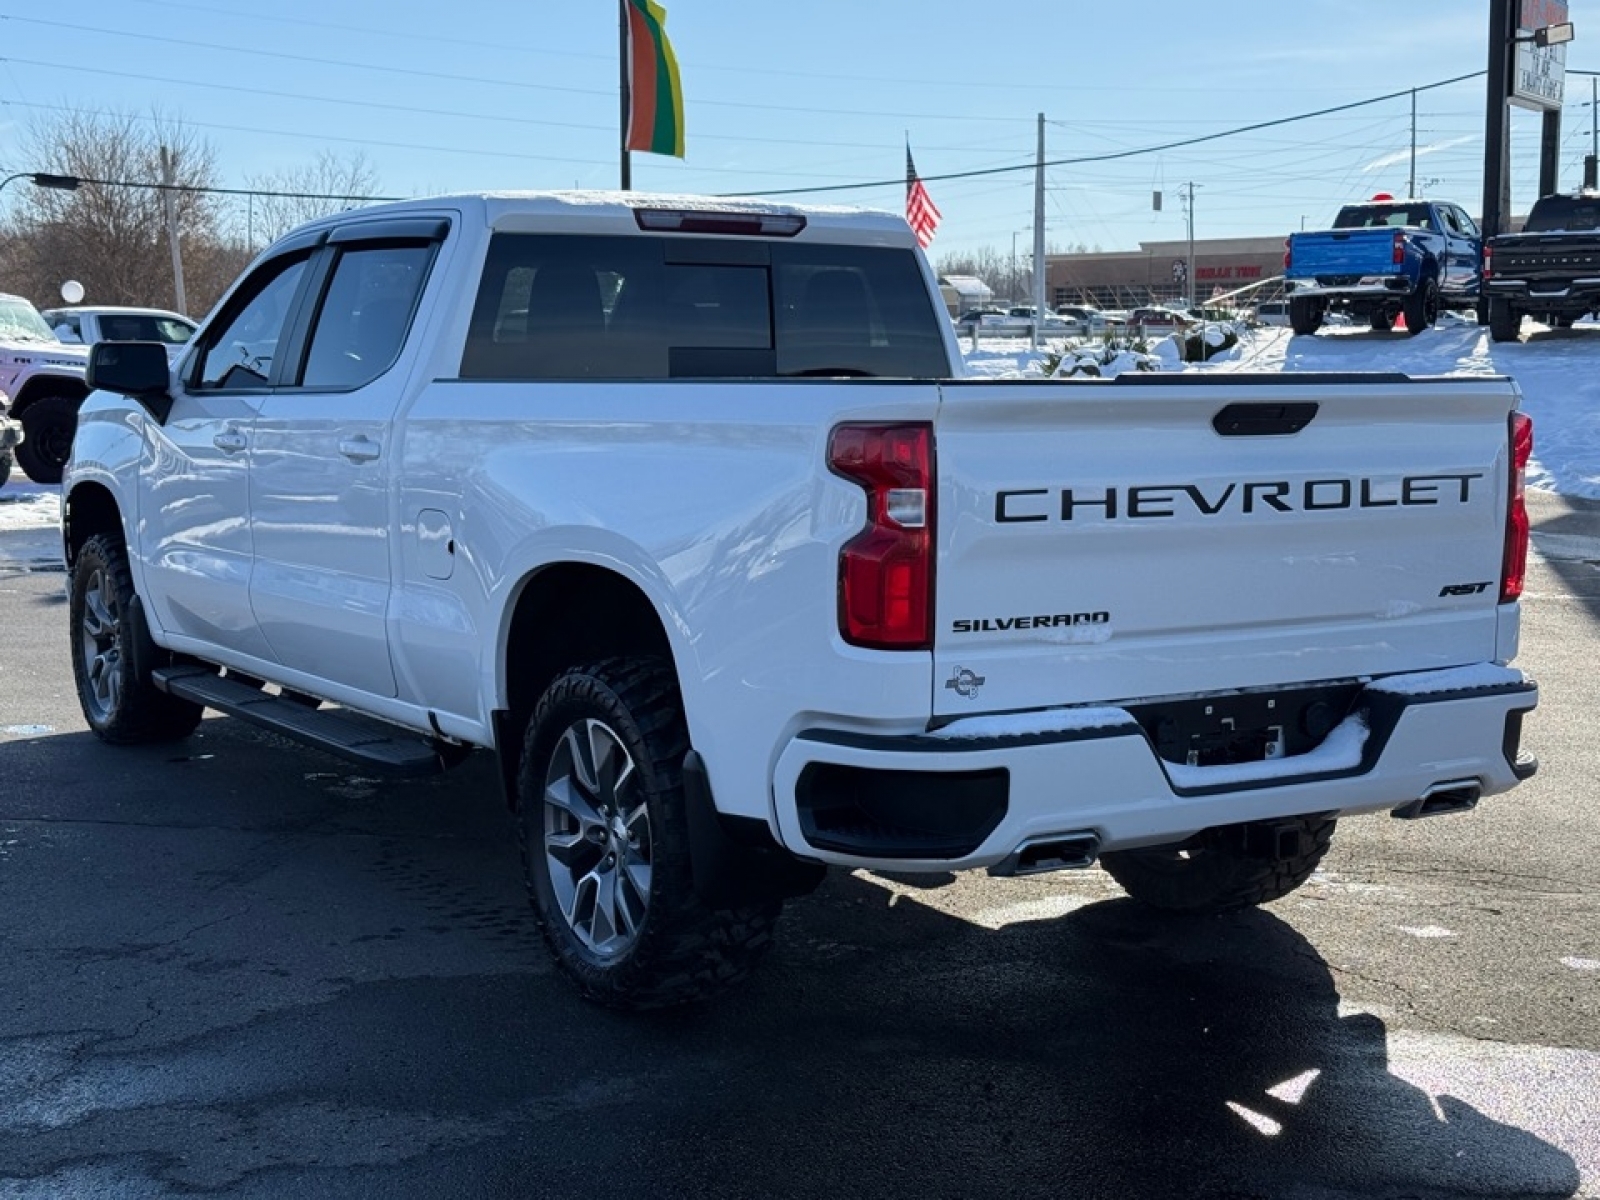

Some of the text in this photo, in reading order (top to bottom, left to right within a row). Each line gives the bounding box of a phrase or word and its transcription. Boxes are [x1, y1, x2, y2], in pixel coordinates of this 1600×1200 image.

[995, 474, 1483, 522] CHEVROLET
[1438, 581, 1493, 597] RST
[952, 611, 1110, 632] SILVERADO
